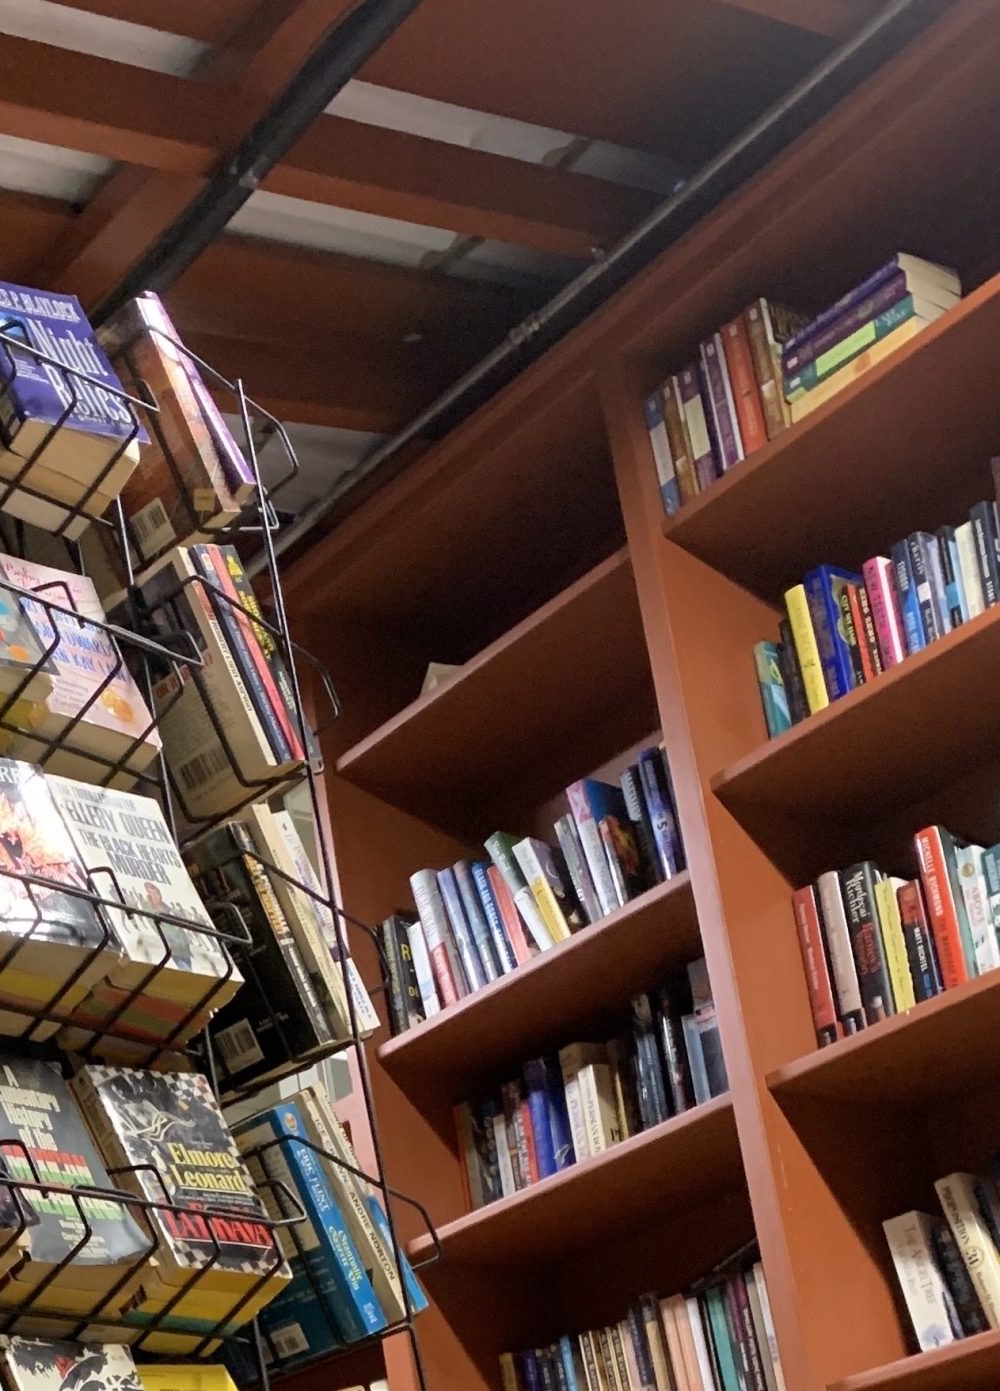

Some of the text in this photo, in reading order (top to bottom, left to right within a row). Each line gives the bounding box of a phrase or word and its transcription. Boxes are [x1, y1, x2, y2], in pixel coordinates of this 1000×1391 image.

[26, 318, 109, 376] Night
[65, 801, 171, 844] ELLERY QUEEN
[106, 851, 172, 886] MURDER
[922, 836, 935, 873] MICHELLE
[167, 1142, 236, 1168] Elmore
[171, 1165, 248, 1193] Leonard
[350, 1191, 396, 1281] ANDRE NORTON
[920, 1281, 937, 1305] TREE
